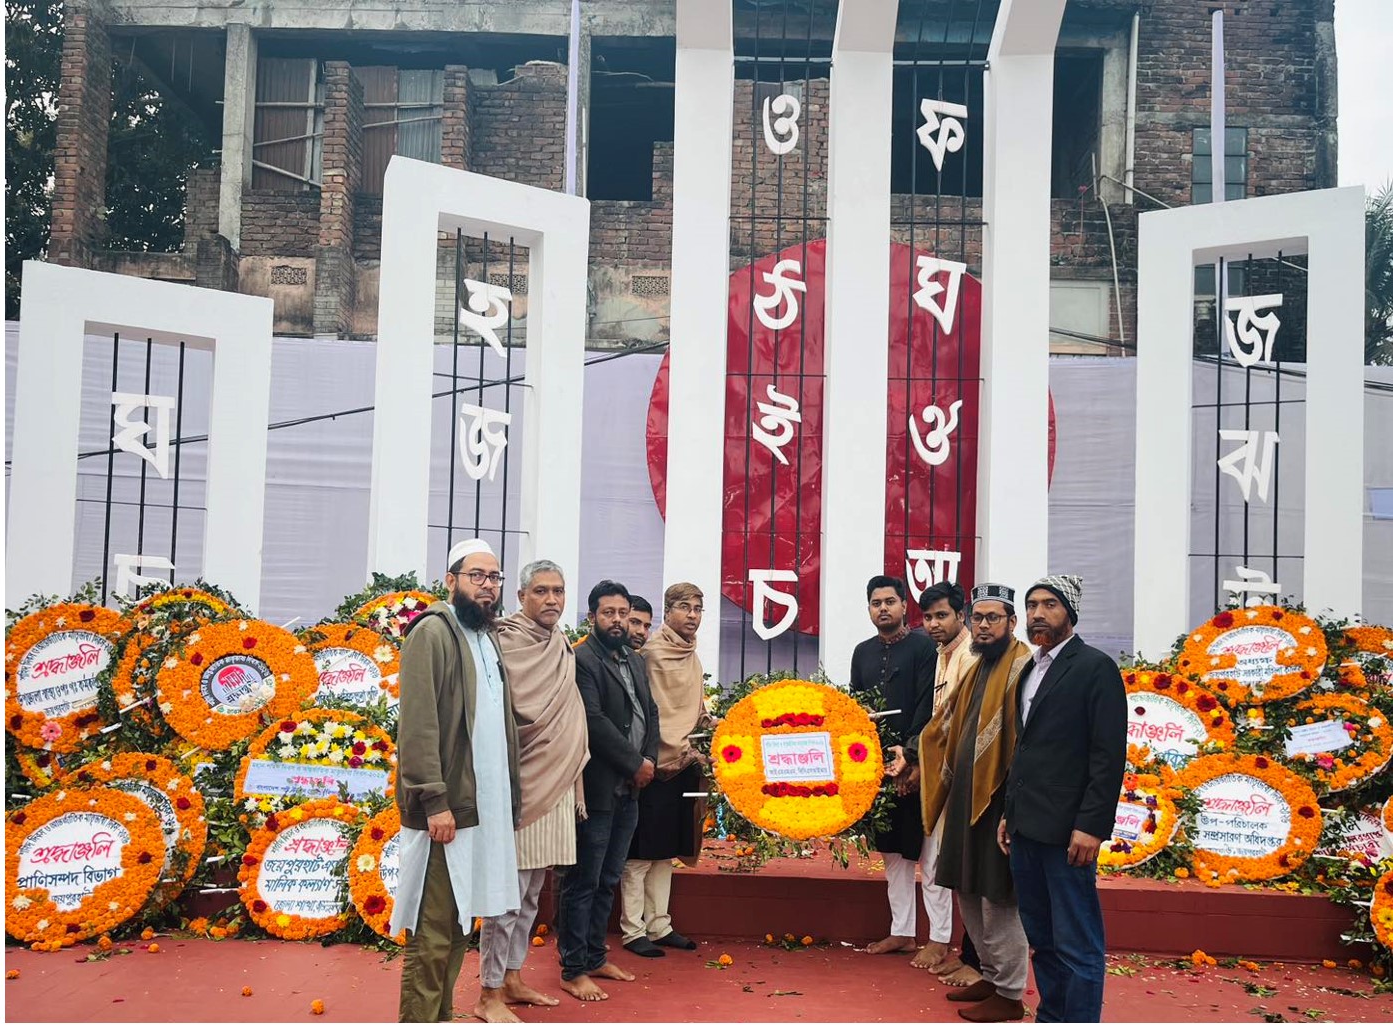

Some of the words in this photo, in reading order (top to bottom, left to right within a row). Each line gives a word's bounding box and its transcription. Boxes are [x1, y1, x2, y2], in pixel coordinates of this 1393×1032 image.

[762, 94, 801, 155] ও
[916, 98, 968, 172] ফ
[459, 278, 512, 358] হ
[1224, 293, 1283, 367] জ
[459, 402, 512, 481] জ
[748, 569, 798, 640] চ
[768, 748, 825, 767] শ্রদ্ধাঞ্জলি
[16, 869, 83, 889] প্রাণিসম্পদ
[83, 864, 121, 884] বিভাগ
[30, 831, 115, 864] শ্রদ্ধাঞ্জলি
[264, 875, 297, 892] মালিক
